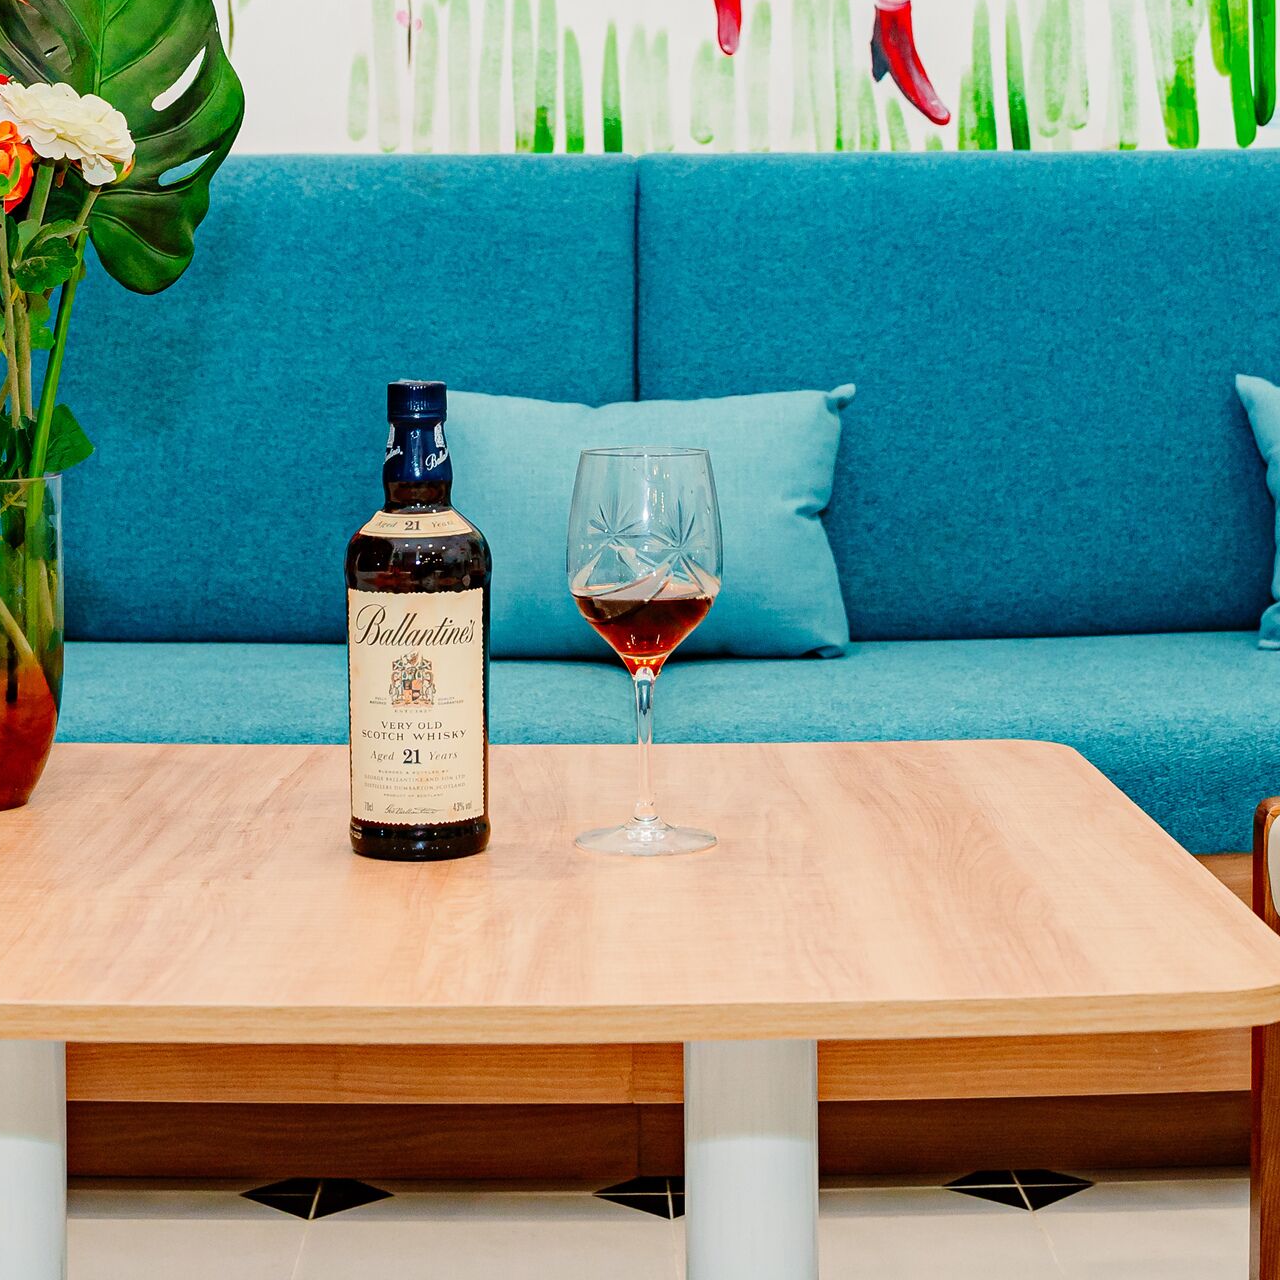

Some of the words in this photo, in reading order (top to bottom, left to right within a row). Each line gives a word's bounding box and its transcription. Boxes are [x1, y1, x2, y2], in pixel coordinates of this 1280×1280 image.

[404, 520, 421, 531] 21
[355, 603, 475, 646] Ballantine's
[381, 721, 413, 729] VERY
[418, 721, 443, 729] OLD
[361, 730, 404, 740] SCOTCH
[412, 730, 468, 740] WHISKY
[370, 750, 395, 762] Aged
[403, 749, 422, 764] 21
[429, 751, 458, 760] Years
